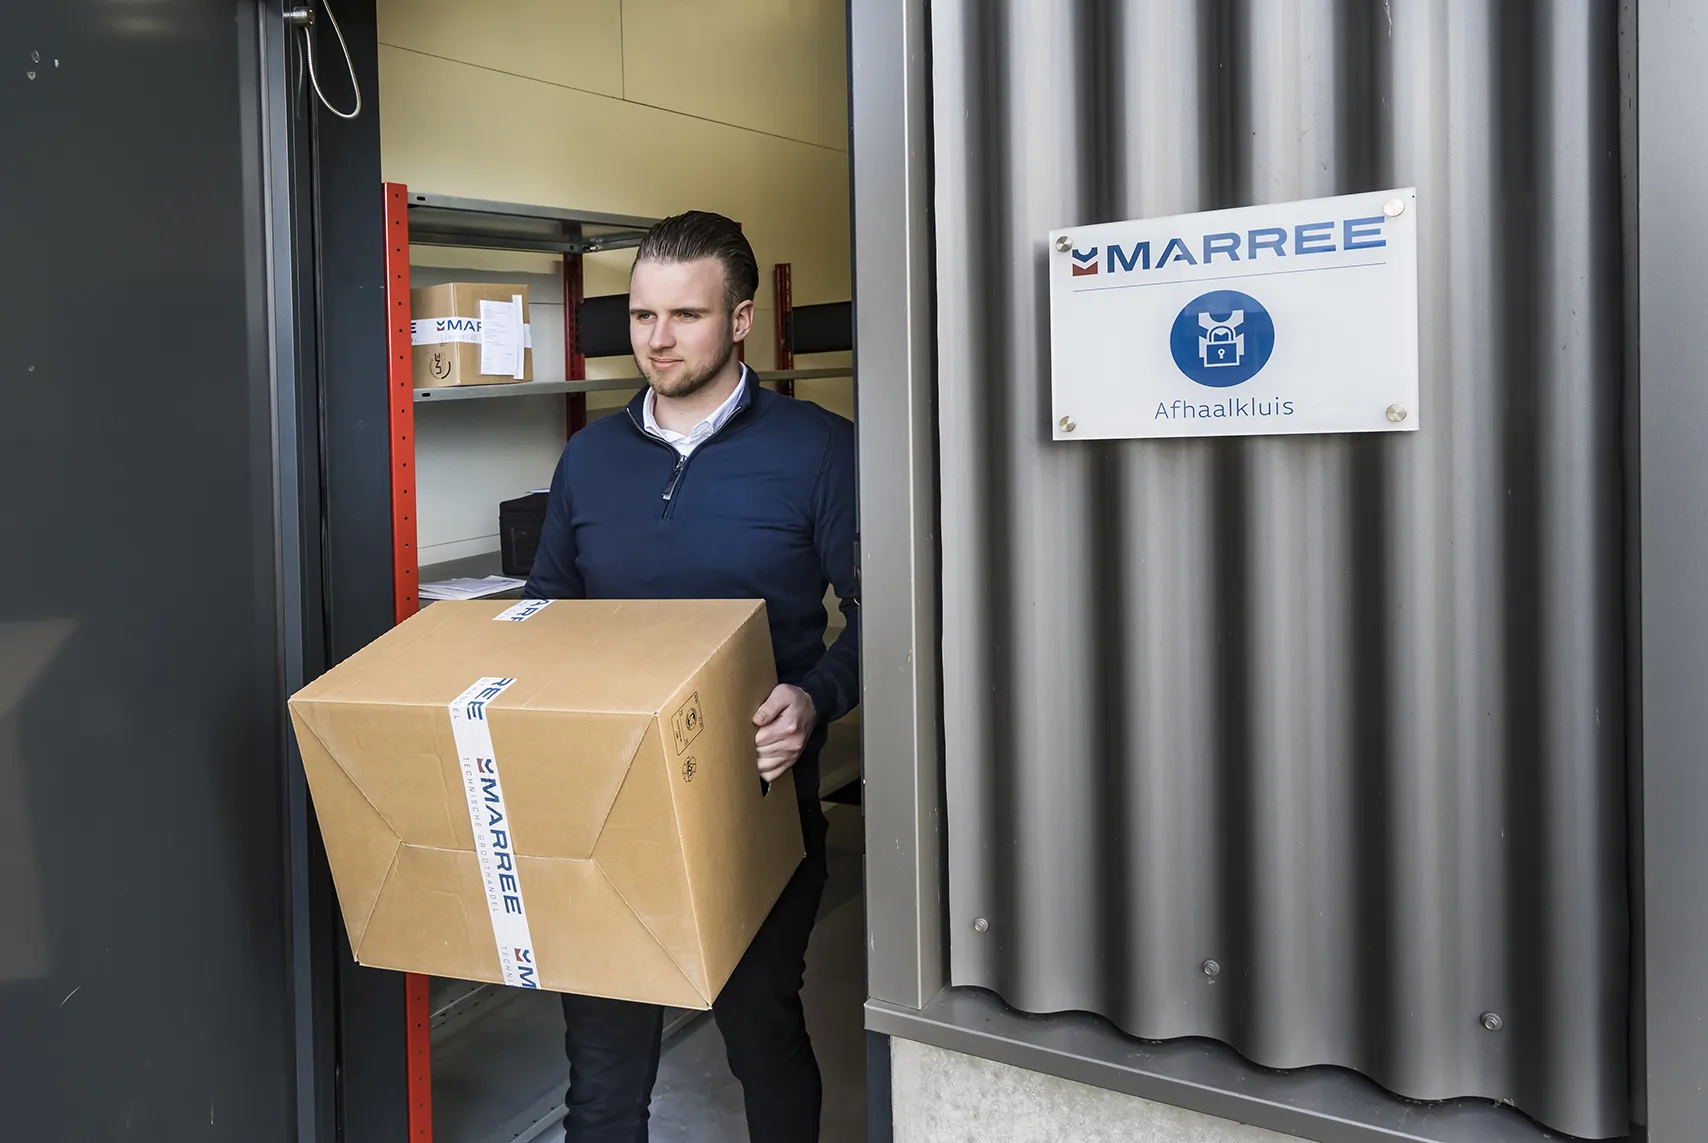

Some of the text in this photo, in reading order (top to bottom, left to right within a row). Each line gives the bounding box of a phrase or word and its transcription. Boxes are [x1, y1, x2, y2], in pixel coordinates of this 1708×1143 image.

[1107, 215, 1387, 274] MARREE
[1154, 396, 1295, 420] Afhaalkluis
[463, 756, 499, 913] TECHNISCHE GROOTHANDEL
[480, 777, 522, 915] MARREE
